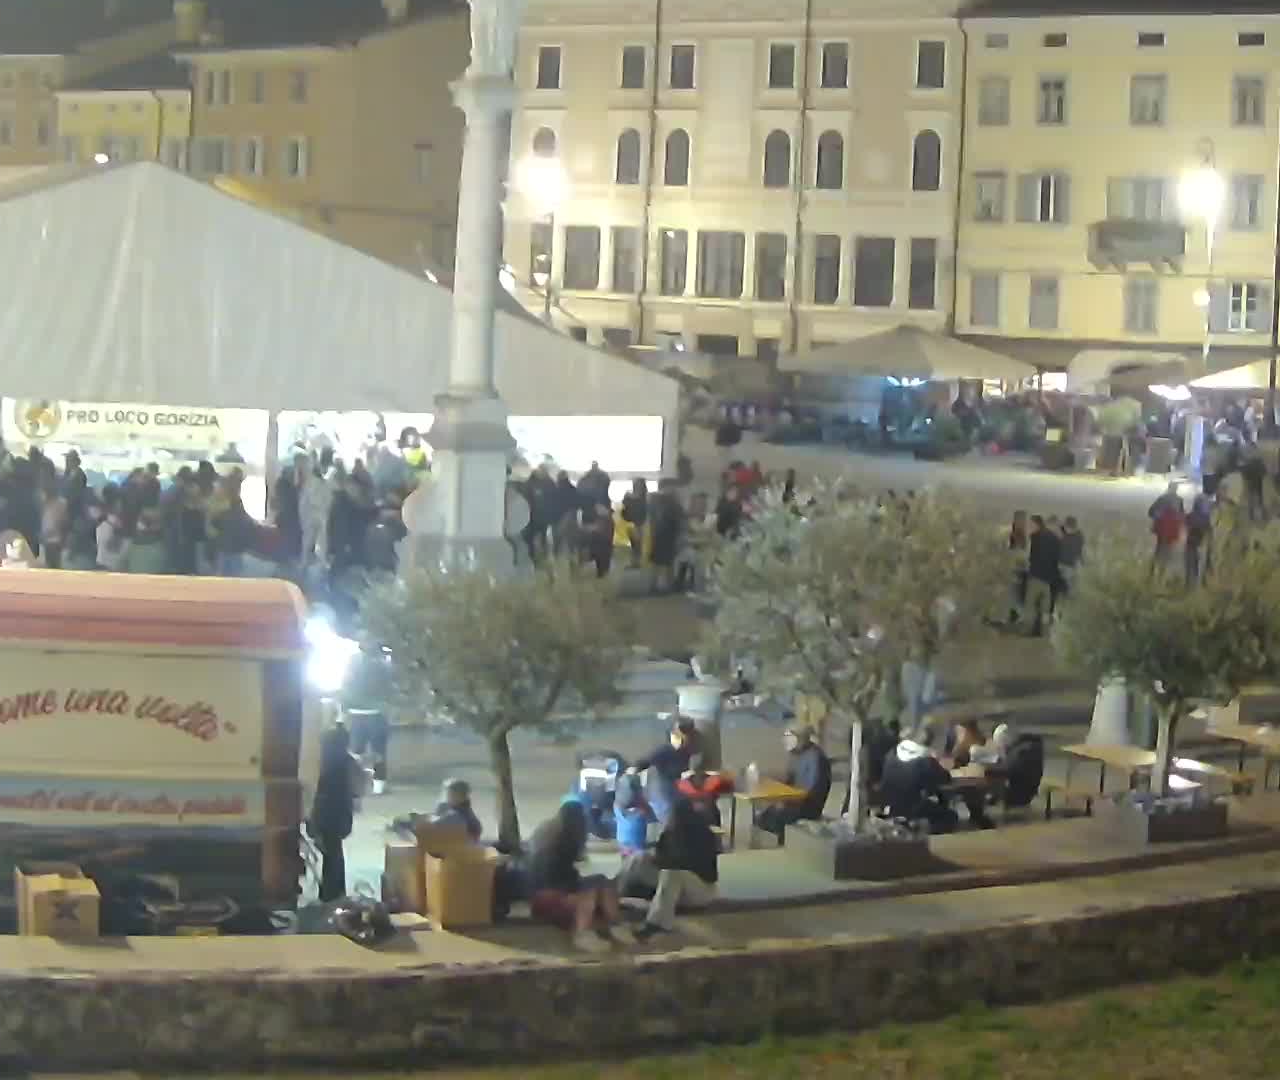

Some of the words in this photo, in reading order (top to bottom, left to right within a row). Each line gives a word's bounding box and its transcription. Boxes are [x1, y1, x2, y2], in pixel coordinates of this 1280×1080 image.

[66, 409, 100, 425] PRO
[104, 410, 149, 426] LOCO
[153, 412, 220, 427] GORIZIA
[63, 687, 130, 715] una
